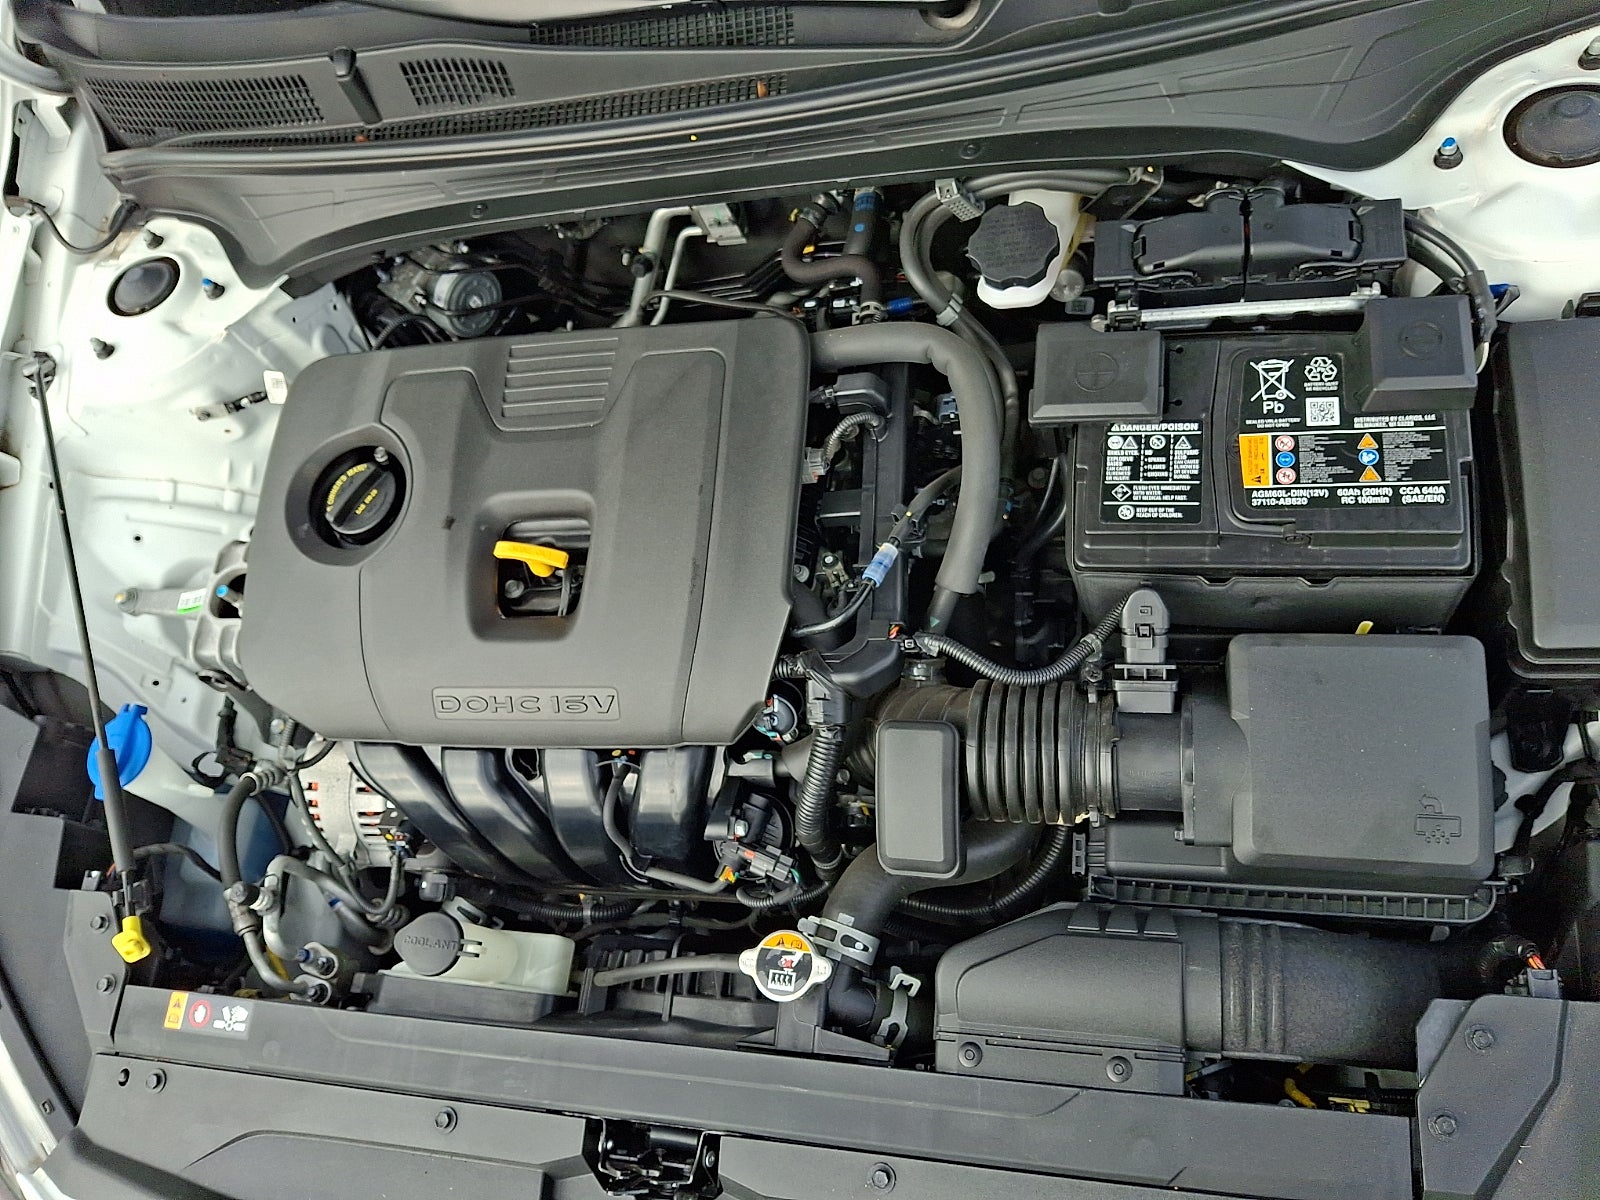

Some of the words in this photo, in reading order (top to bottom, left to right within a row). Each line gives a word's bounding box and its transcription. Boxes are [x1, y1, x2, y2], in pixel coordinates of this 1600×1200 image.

[1262, 400, 1285, 414] Pb
[1120, 423, 1199, 432] DANGER/POISON
[1337, 488, 1361, 496] 60Ah
[1362, 487, 1393, 496] (20HR)
[1399, 486, 1421, 494] CCA
[1421, 486, 1446, 494] 640A
[1401, 494, 1445, 504] (SAE/EN)
[434, 695, 541, 714] DOHC
[550, 694, 615, 714] 16V
[404, 935, 458, 950] COOLANT
